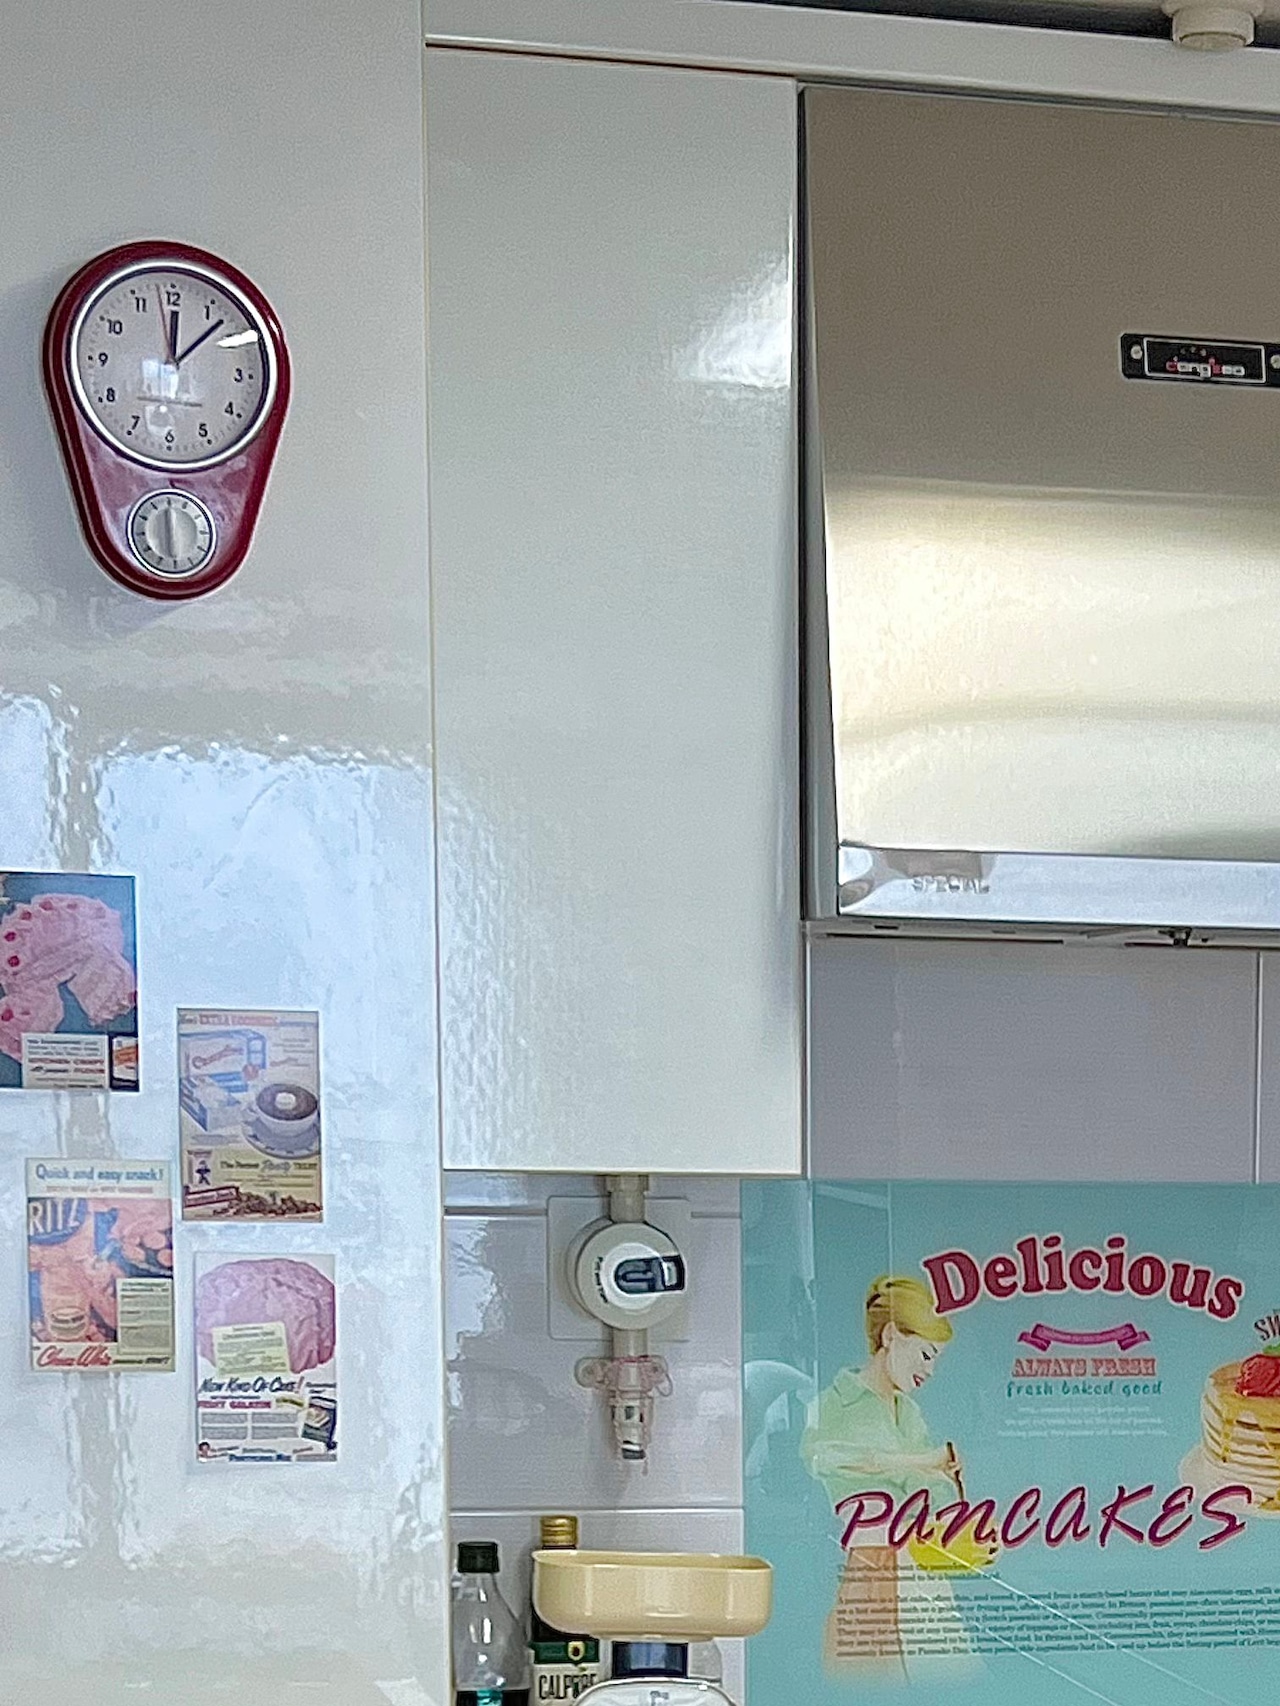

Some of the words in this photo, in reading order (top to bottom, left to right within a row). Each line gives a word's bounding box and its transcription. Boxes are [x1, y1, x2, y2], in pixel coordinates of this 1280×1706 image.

[135, 298, 147, 312] 11
[166, 291, 181, 306] 12
[204, 305, 210, 320] 1
[106, 320, 123, 335] 10
[98, 353, 108, 366] 9
[234, 369, 243, 382] 3
[106, 388, 116, 402] 8
[225, 402, 234, 416] 4
[131, 415, 140, 430] 7
[165, 430, 175, 443] 6
[199, 424, 208, 437] 5
[912, 875, 990, 894] SPECIAL
[29, 1198, 81, 1236] RITZ
[922, 1236, 1243, 1319] Delicious
[1012, 1358, 1087, 1377] ALWAYS
[1091, 1358, 1156, 1377] FRESH
[1006, 1380, 1053, 1397] fresh
[1062, 1380, 1114, 1395] baked
[1122, 1380, 1162, 1397] good
